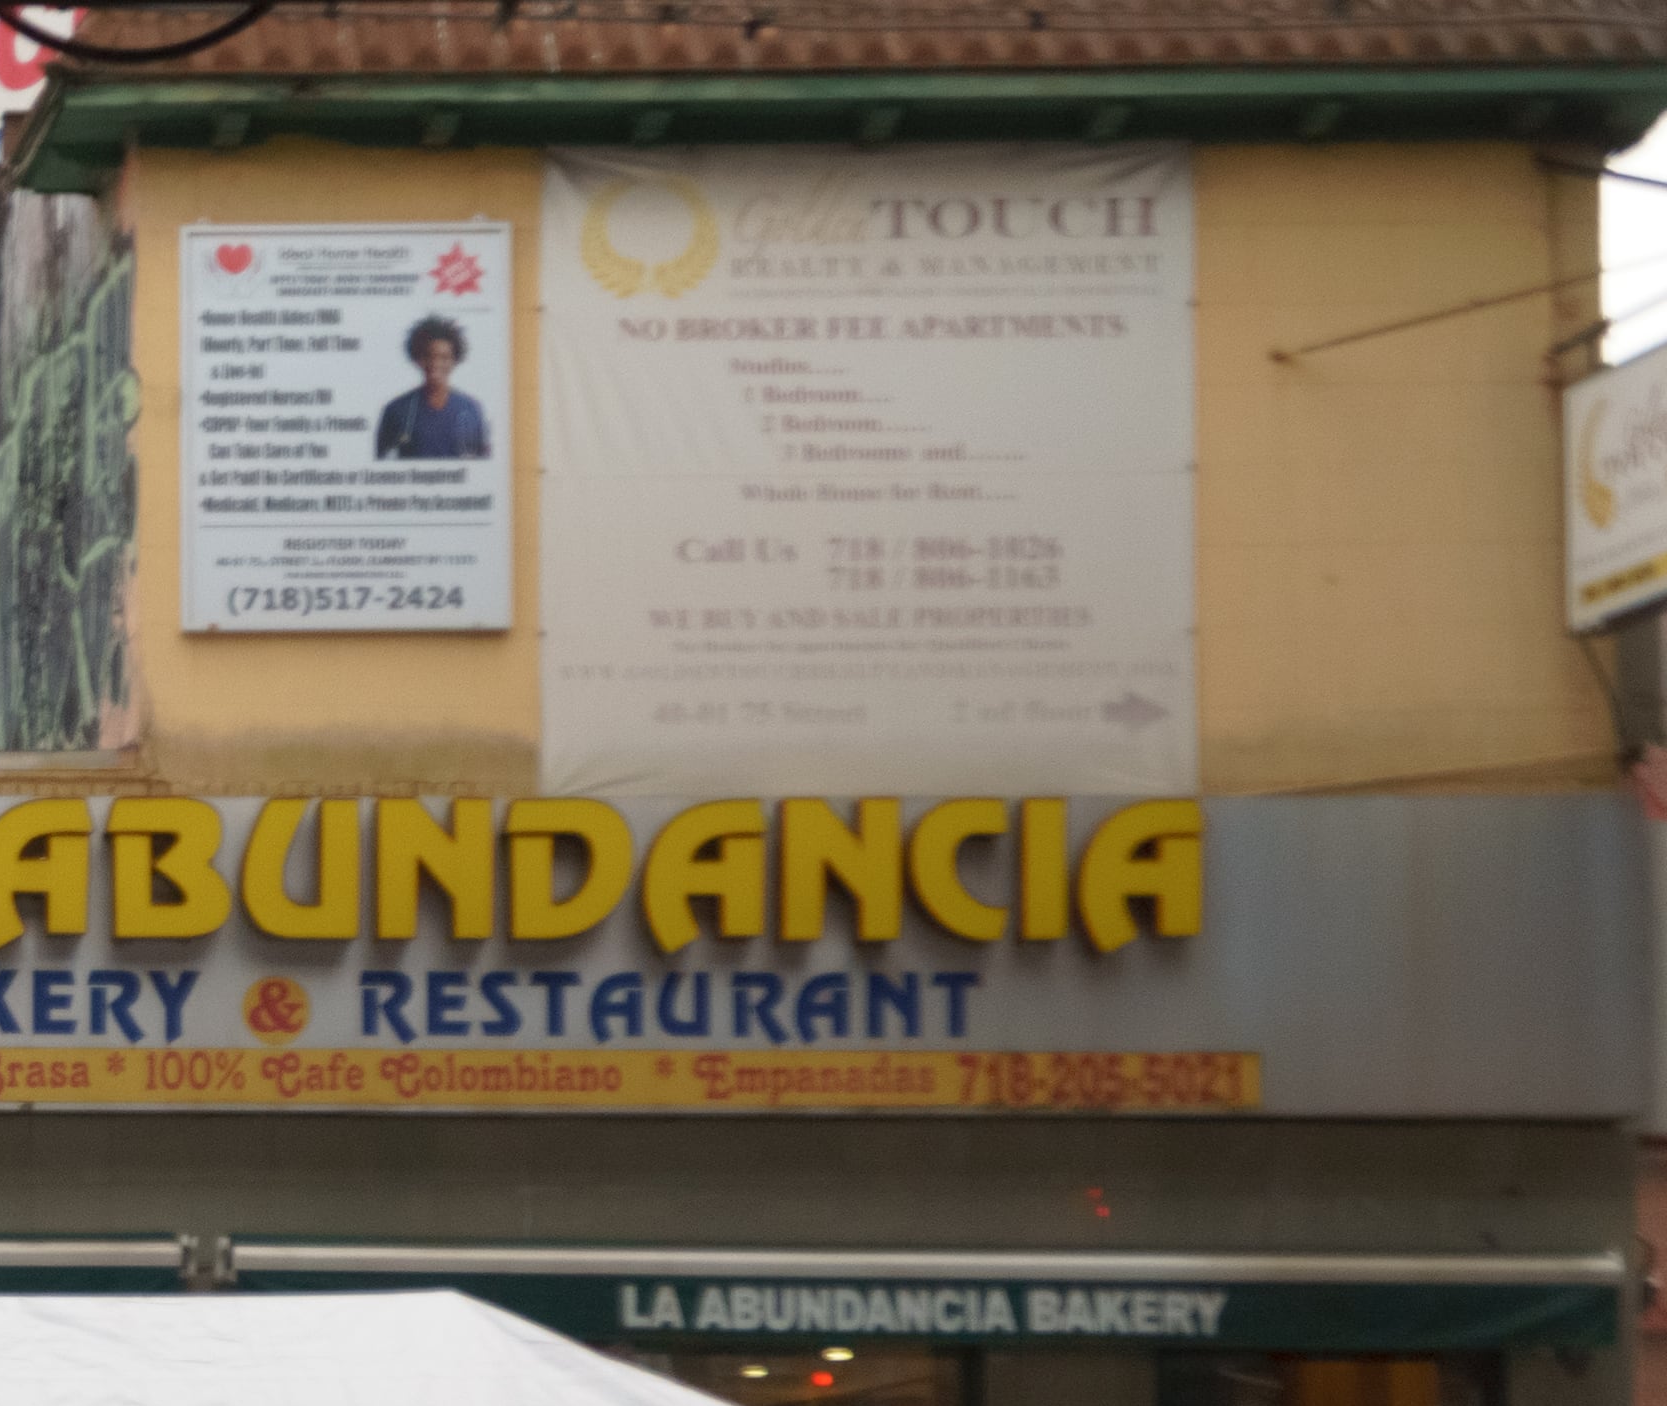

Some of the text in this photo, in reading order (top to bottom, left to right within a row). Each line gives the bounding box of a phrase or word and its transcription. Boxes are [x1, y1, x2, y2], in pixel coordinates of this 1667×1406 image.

[871, 197, 1160, 239] TOUCH
[619, 315, 1129, 341] NO BROKER FEE APARTMENTS
[226, 585, 466, 617] (718)517-2424
[252, 974, 307, 1036] &
[357, 965, 986, 1041] RESTAURANT
[144, 1051, 246, 1092] 100%
[260, 1052, 366, 1099] Cafe
[379, 1052, 625, 1099] Colombiano
[691, 1052, 937, 1103] Empanadas
[620, 1285, 1229, 1339] LA ABUNDANCIA BAKERY
